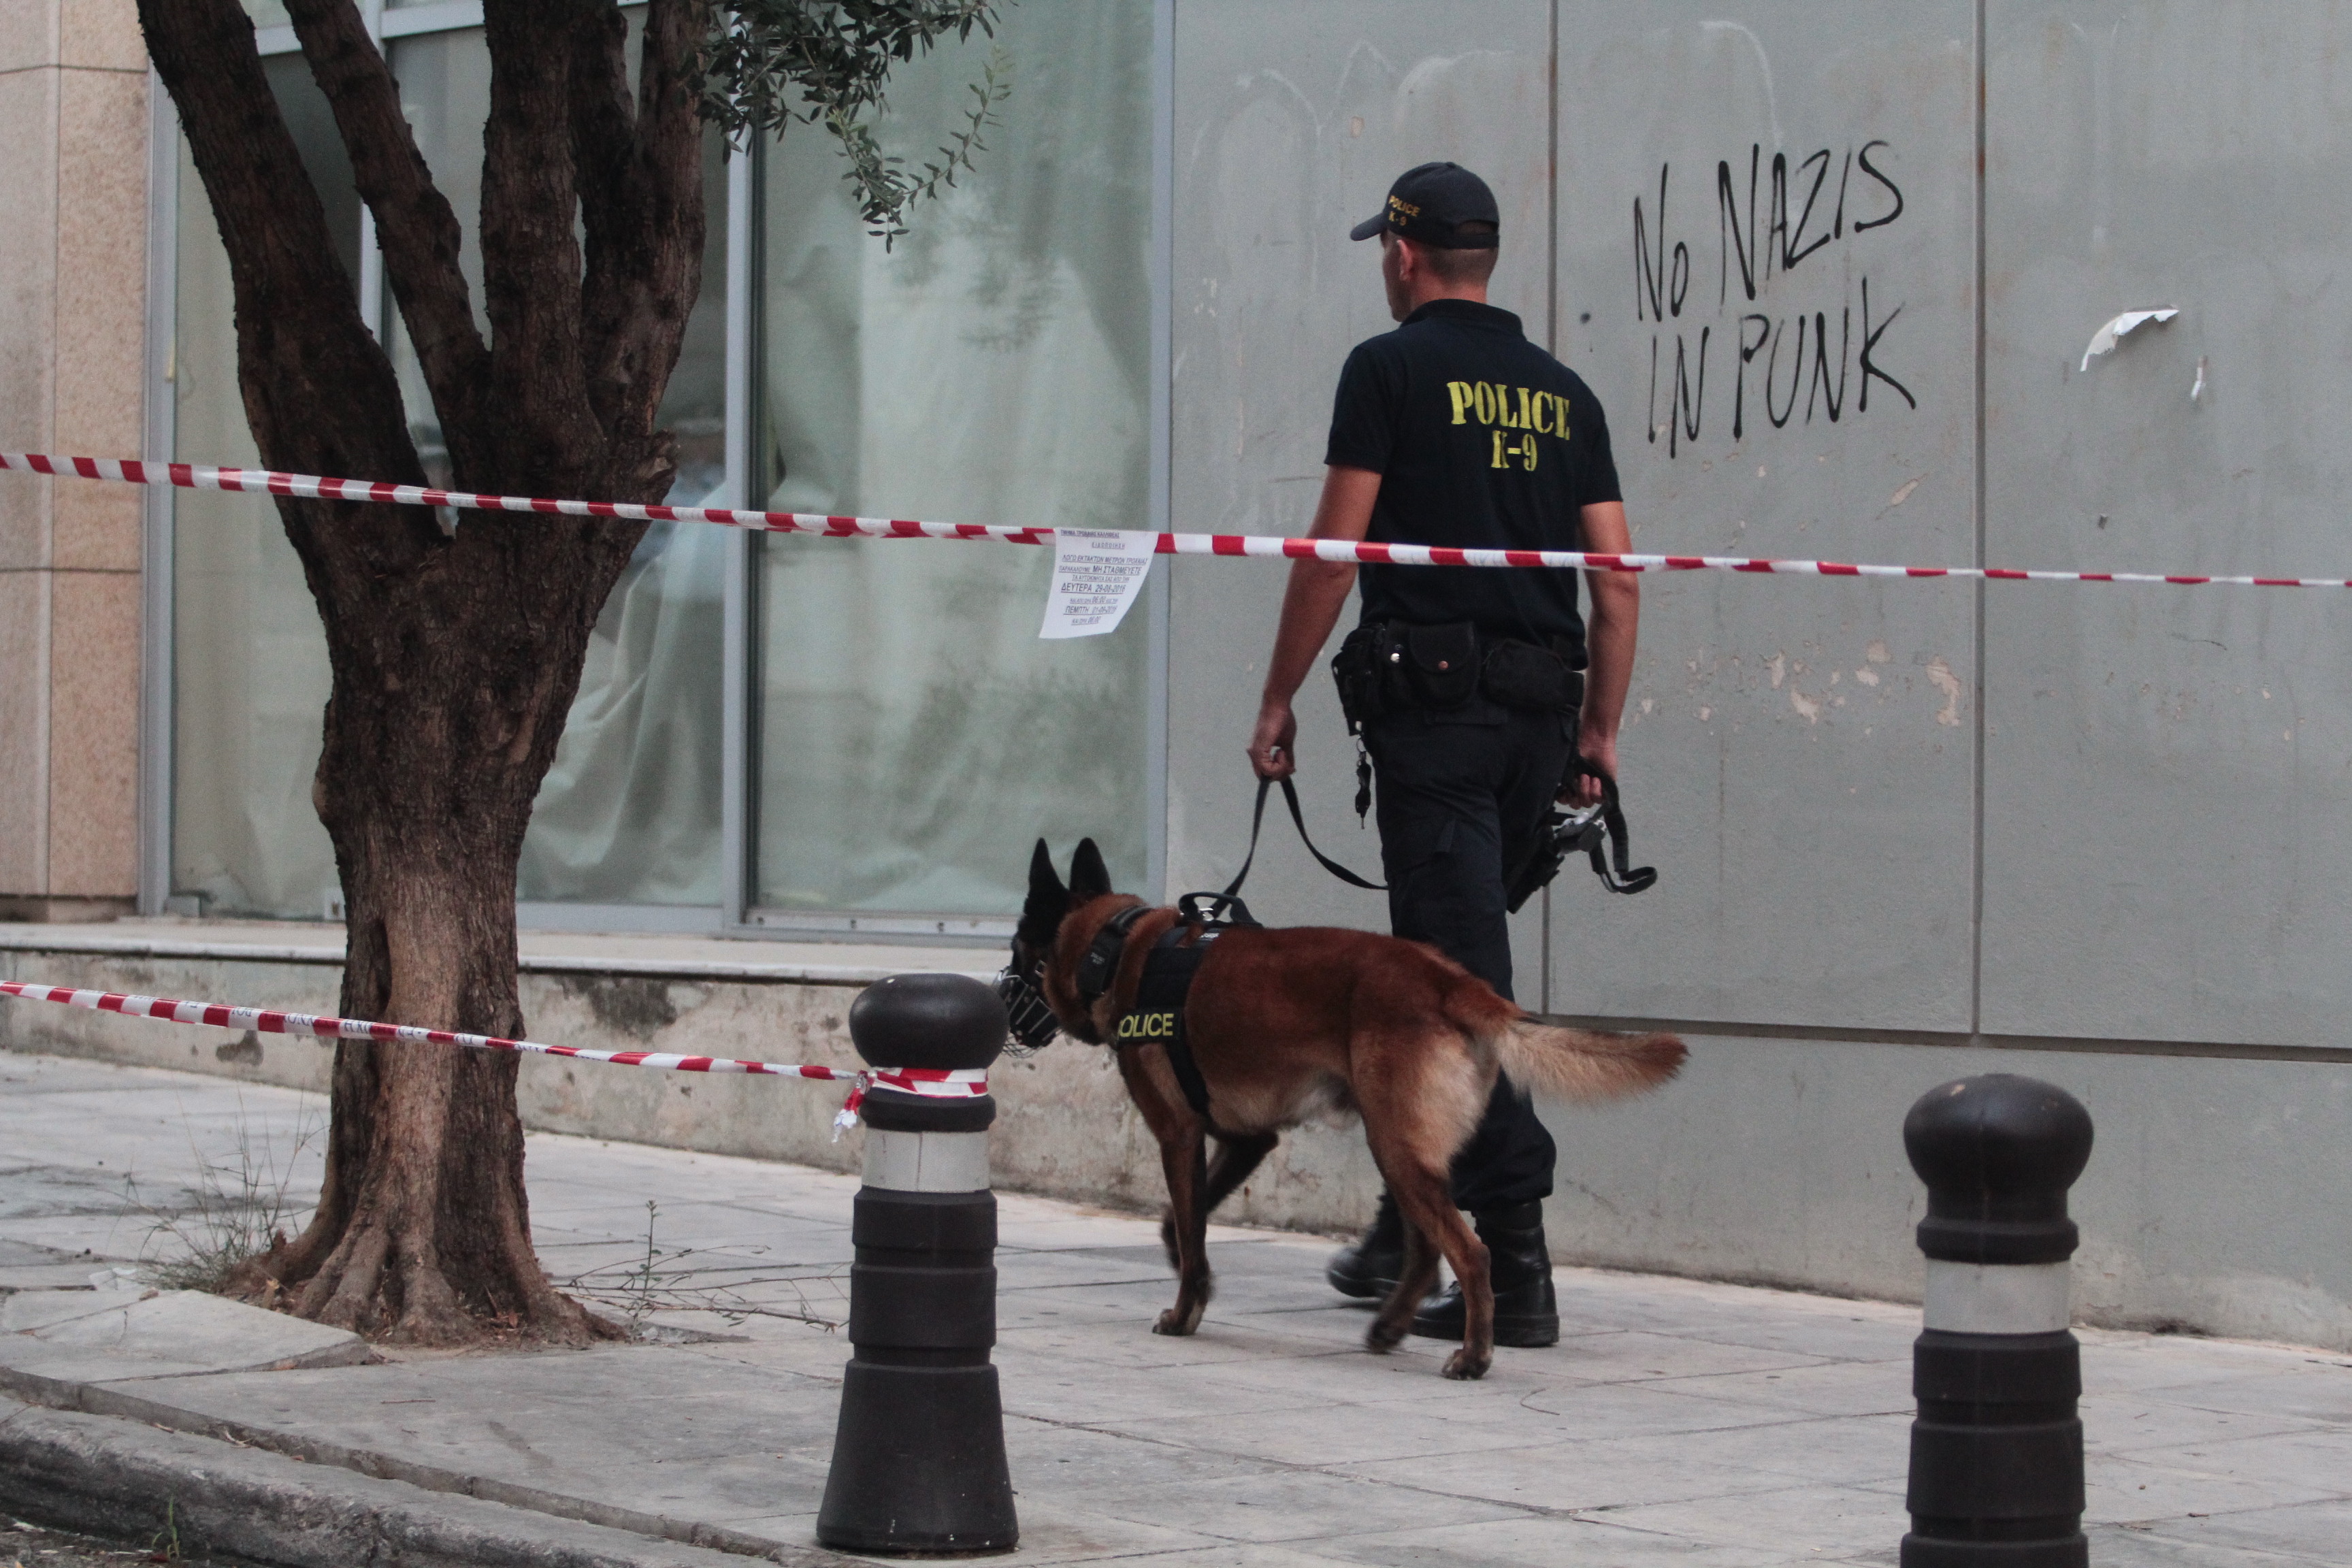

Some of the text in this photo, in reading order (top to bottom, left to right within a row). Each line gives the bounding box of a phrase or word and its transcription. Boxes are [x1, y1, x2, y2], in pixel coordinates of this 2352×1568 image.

[1388, 195, 1421, 217] POLICE
[1388, 210, 1407, 226] K-9
[1718, 140, 1904, 306] NAZIS
[1648, 274, 1917, 459] IN PUNK
[1446, 380, 1571, 440] POLICE
[1490, 430, 1538, 472] K-9
[1077, 555, 1104, 564] ΕΚΤΑΚΤΩΝ
[1104, 556, 1125, 564] ΜΕΤΡΩΝ
[1092, 566, 1102, 574] ΜΗ
[1103, 566, 1142, 575] ΣΤΑΘΜΕΥΕΤΕ
[1062, 583, 1092, 591] ΔΕΥΤΕΡΑ
[1065, 606, 1090, 614] ΠΕΜΠΤΗ
